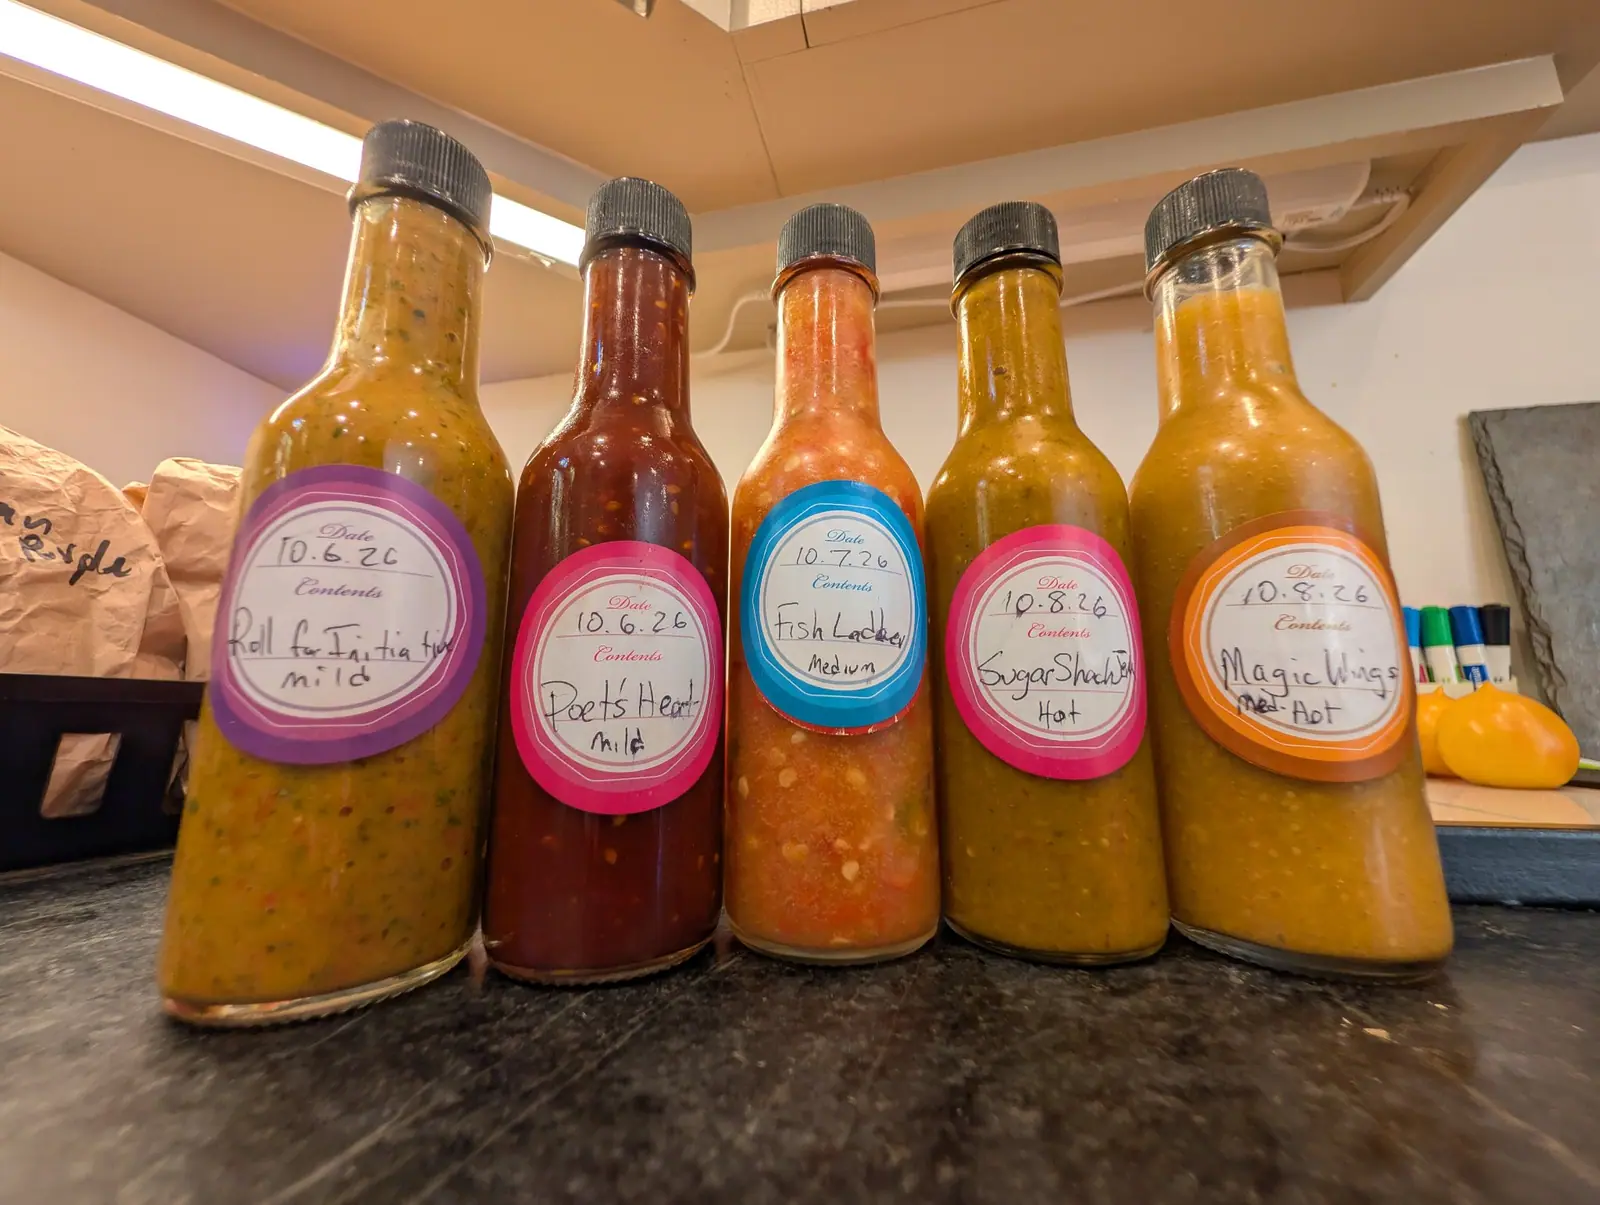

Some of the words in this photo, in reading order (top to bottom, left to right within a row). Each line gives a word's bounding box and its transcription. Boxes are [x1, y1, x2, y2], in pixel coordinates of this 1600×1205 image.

[316, 522, 374, 542] Date
[825, 529, 865, 544] Date
[796, 547, 888, 568] 10.7.26
[1285, 564, 1334, 579] Date
[294, 577, 383, 598] Contents
[812, 574, 873, 592] Contents
[1036, 576, 1079, 590] Date
[606, 595, 652, 611] Date
[228, 606, 274, 657] Roll
[290, 618, 321, 657] for
[577, 611, 687, 635] 10.6.26
[774, 602, 823, 641] Fish
[1027, 622, 1091, 639] Contents
[1274, 614, 1352, 631] Contents
[593, 645, 663, 663] Contents
[808, 654, 876, 675] Medium
[1221, 647, 1321, 697] Magic
[1324, 648, 1399, 700] Wings
[541, 677, 628, 732] Poet's
[1038, 699, 1081, 729] Hot
